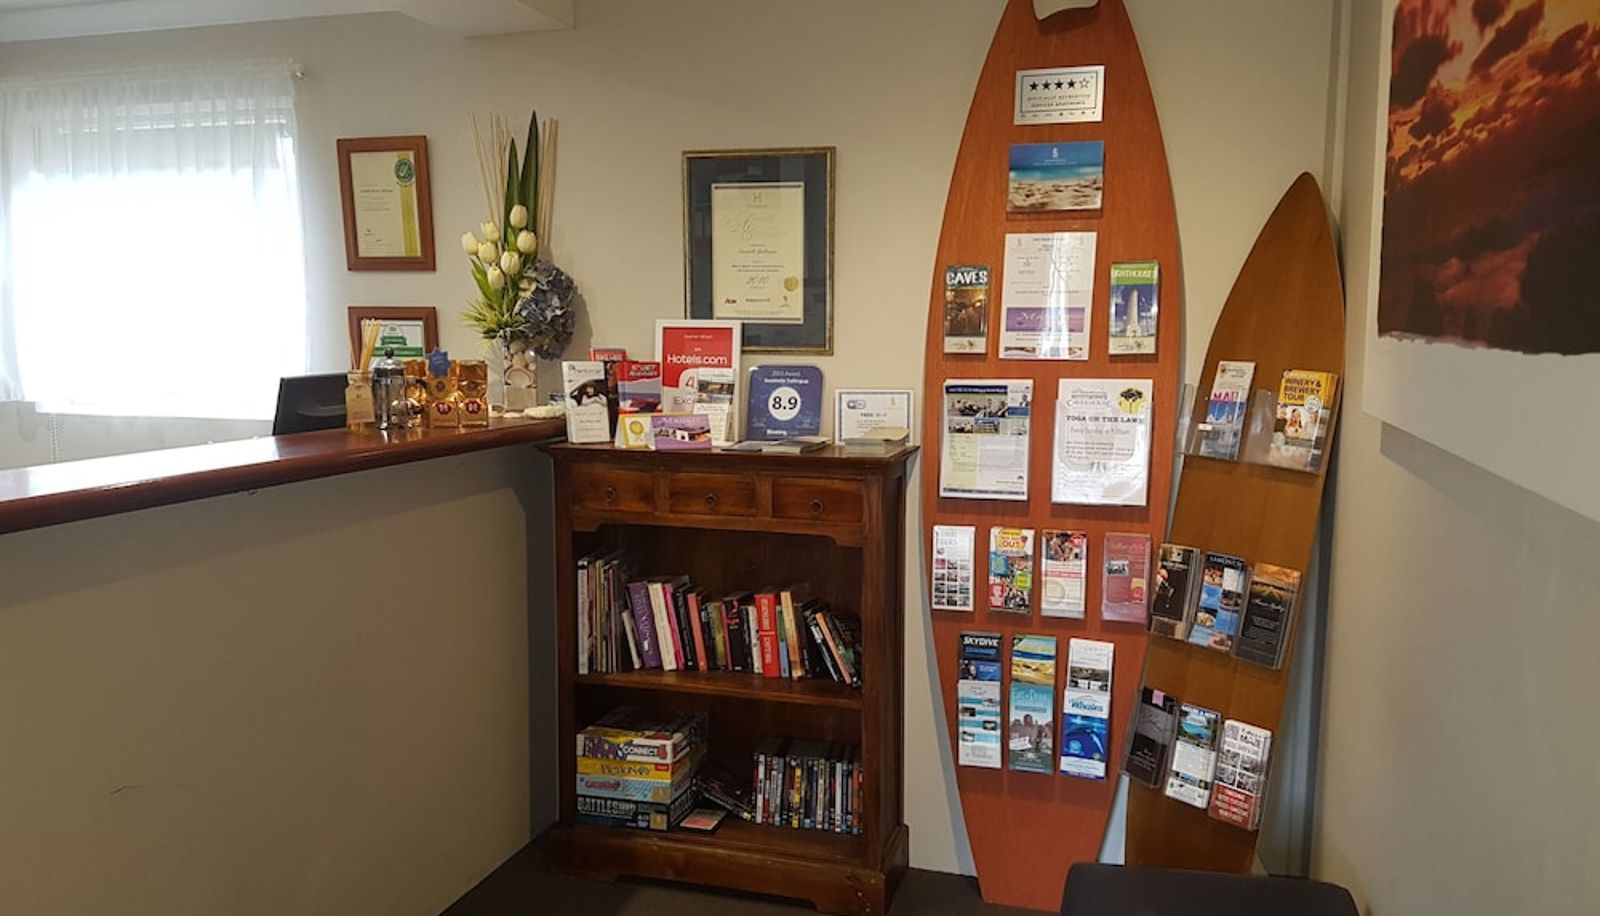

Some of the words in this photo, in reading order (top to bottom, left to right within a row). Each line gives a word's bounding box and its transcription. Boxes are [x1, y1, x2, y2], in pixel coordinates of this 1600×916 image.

[946, 270, 988, 285] CAVES
[667, 353, 728, 365] Hotels.com
[1313, 379, 1322, 387] &
[1284, 392, 1305, 401] TOUR
[771, 396, 798, 410] 8.9
[963, 635, 999, 647] SKYDIVE
[623, 744, 658, 756] CONNECT
[601, 763, 652, 776] PICTIONARY
[577, 796, 637, 815] BATTLESHIP
